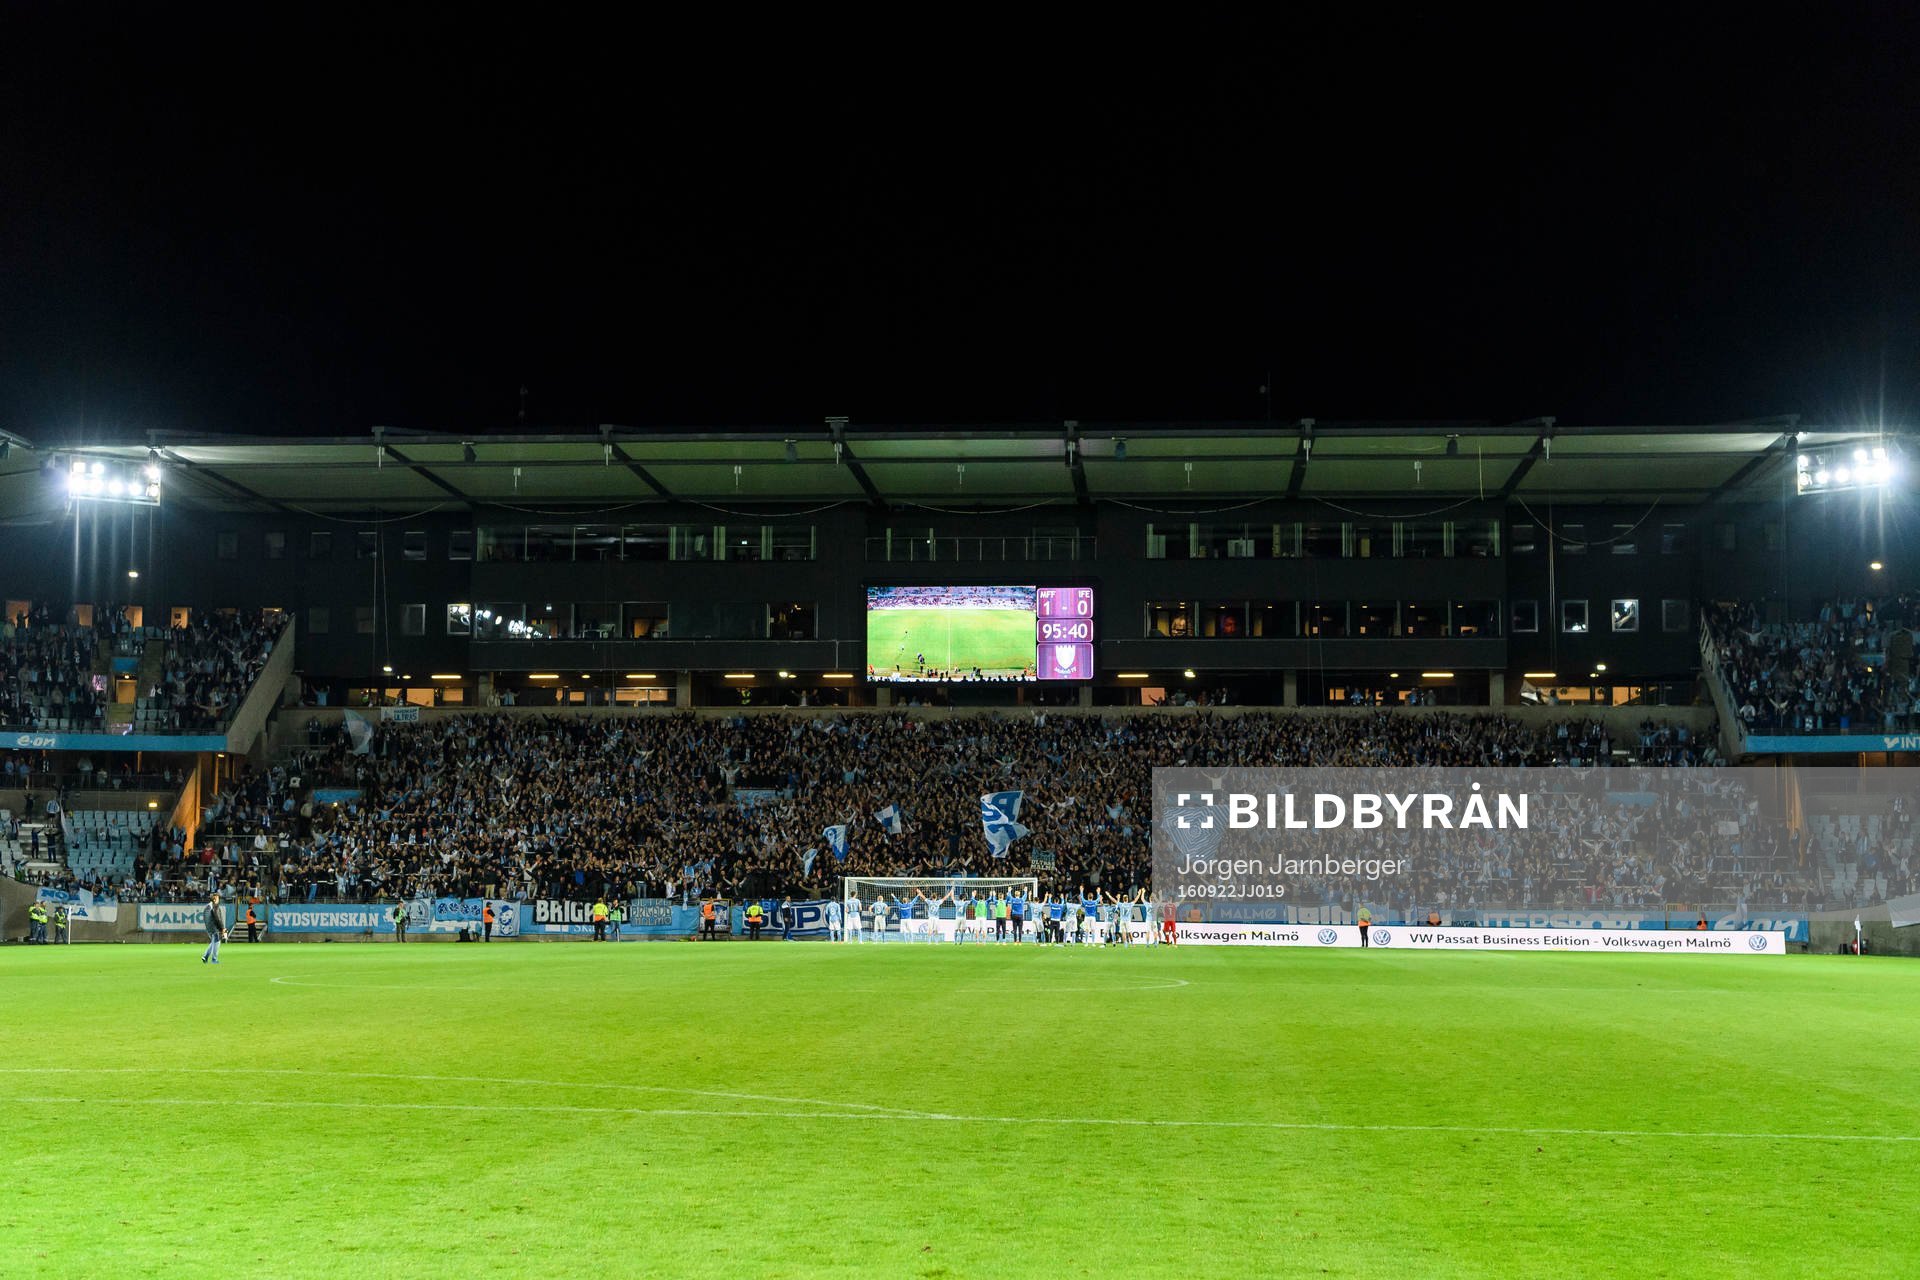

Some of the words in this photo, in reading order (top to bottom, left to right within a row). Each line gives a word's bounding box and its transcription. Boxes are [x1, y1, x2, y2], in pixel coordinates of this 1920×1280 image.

[1040, 591, 1056, 599] MFF
[1078, 591, 1091, 599] IFE
[1044, 601, 1051, 616] 1
[1077, 601, 1088, 616] 0
[1042, 623, 1088, 639] 95:40
[273, 911, 379, 928] SYDSVENSKAN
[1251, 929, 1299, 942] Malmö
[1409, 933, 1433, 944] VW
[1437, 934, 1479, 945] Passat
[1483, 934, 1540, 946] Business
[1544, 935, 1590, 946] Edition
[1602, 936, 1682, 950] Volkswagen
[1687, 936, 1731, 949] Malmö
